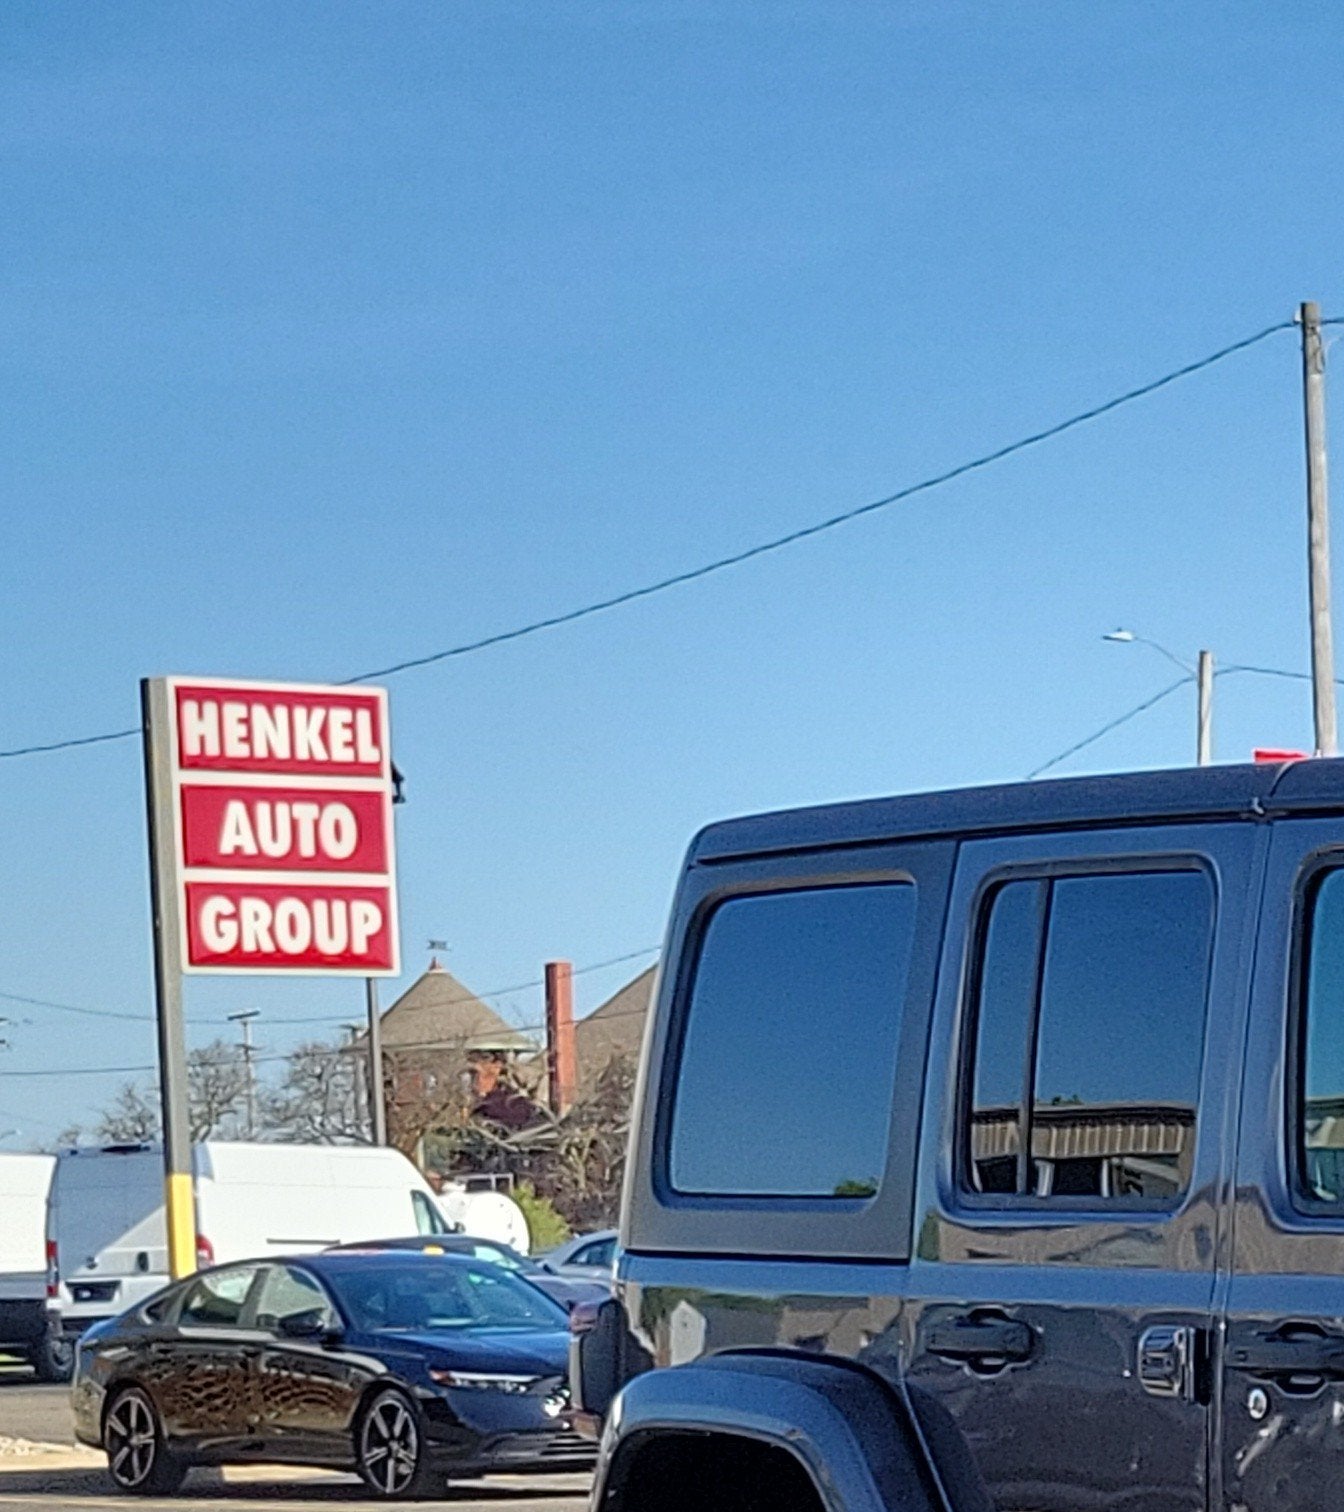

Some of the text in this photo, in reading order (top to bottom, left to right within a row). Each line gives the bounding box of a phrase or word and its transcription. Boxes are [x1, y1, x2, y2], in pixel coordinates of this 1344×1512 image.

[182, 700, 381, 764] HENKEL
[218, 800, 358, 860] AUTO
[199, 895, 383, 956] GROUP
